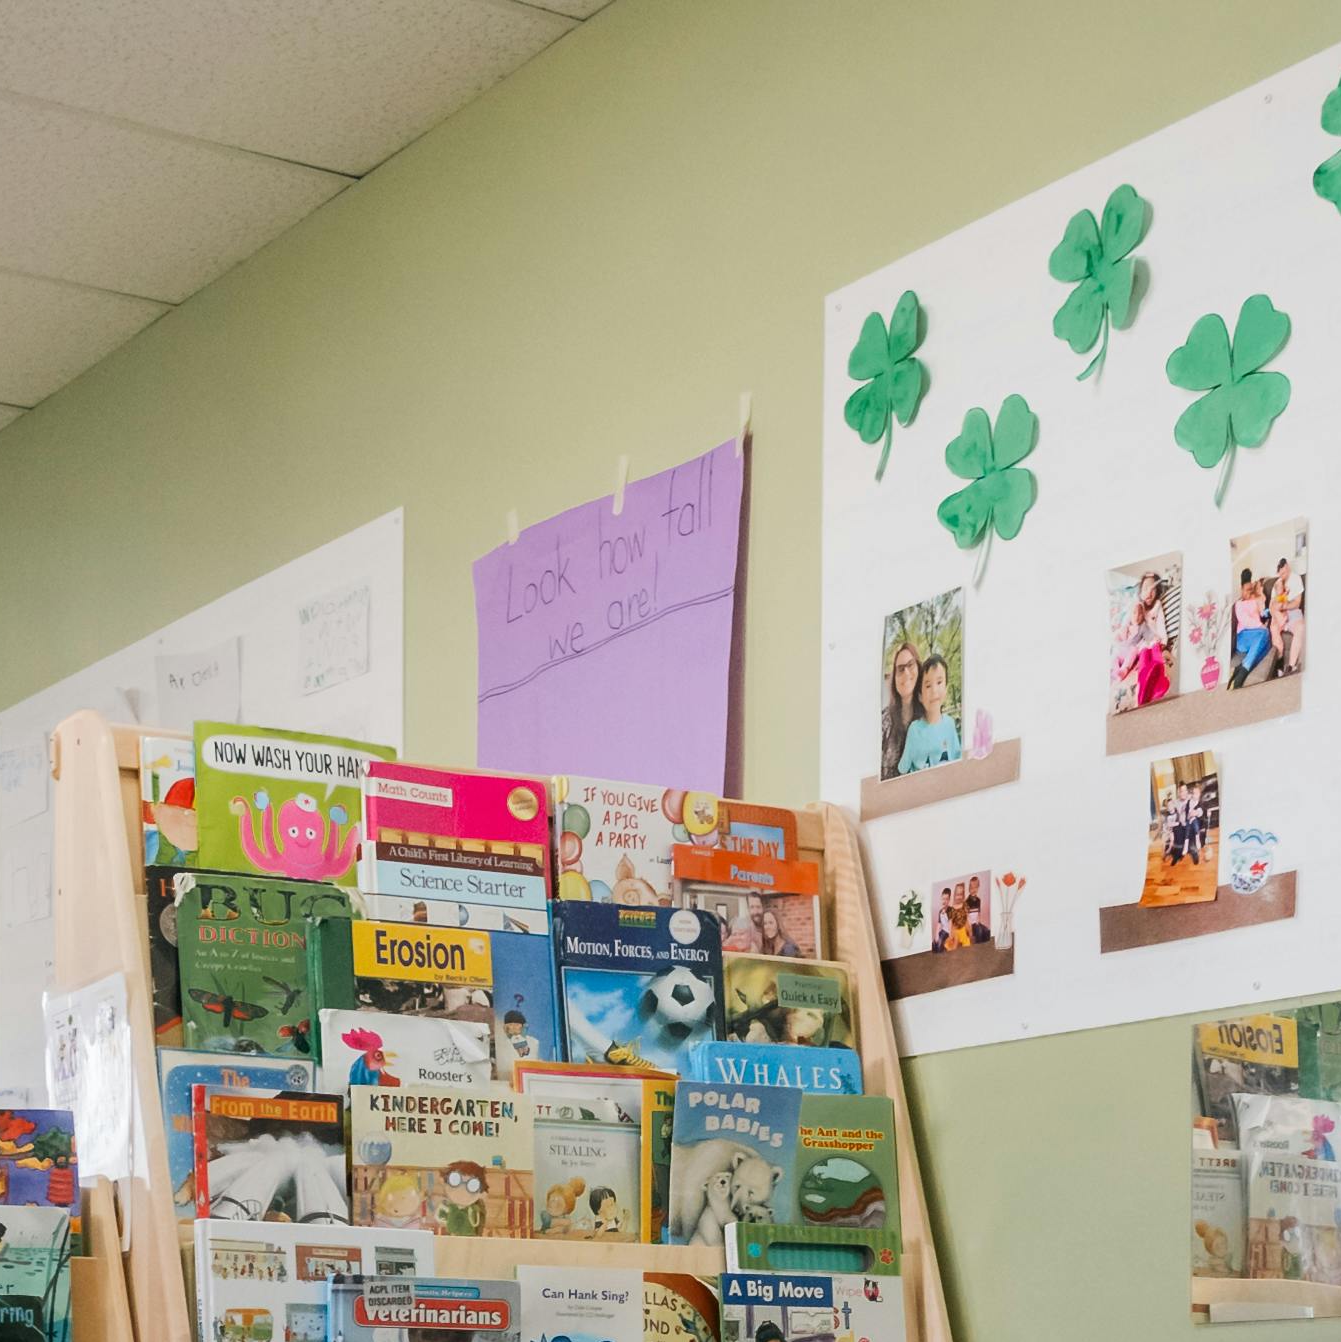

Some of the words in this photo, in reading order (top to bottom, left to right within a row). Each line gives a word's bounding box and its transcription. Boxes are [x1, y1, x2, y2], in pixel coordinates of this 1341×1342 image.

[507, 536, 576, 623] Look
[598, 506, 645, 579] how
[662, 452, 714, 544] tall
[548, 622, 584, 660] we
[607, 552, 658, 630] are!
[214, 742, 246, 765] NOW
[252, 746, 291, 770] WASH
[296, 751, 332, 775] YOUR
[378, 782, 407, 797] Math
[410, 787, 448, 803] Counts
[583, 787, 596, 802] IF
[599, 790, 625, 809] YOU
[627, 793, 657, 812] GIVE
[603, 811, 613, 825] A
[615, 812, 638, 829] PIG
[596, 832, 604, 847] A
[608, 833, 647, 850] PARTY
[389, 846, 396, 857] A
[396, 846, 427, 860] Child's
[429, 850, 448, 861] First
[451, 852, 483, 867] Library
[484, 855, 492, 866] of
[494, 856, 534, 872] Learning
[400, 868, 463, 891] Science
[467, 875, 526, 898] Starter
[375, 930, 465, 970] Erosion
[566, 935, 614, 957] MOTION,
[614, 939, 654, 960] FORCES,
[670, 943, 709, 963] ENERGY
[781, 990, 807, 1001] Quick
[818, 993, 838, 1008] Easy
[221, 1068, 251, 1089] The
[418, 1068, 472, 1083] Rooster's
[715, 1056, 843, 1091] WHALES
[210, 1097, 254, 1116] From
[260, 1101, 282, 1115] the
[289, 1102, 337, 1122] Earth
[369, 1093, 519, 1123] KINDERGARTEN,
[689, 1091, 761, 1114] POLAR
[384, 1116, 427, 1134] HERE
[433, 1117, 442, 1135] I
[448, 1119, 500, 1138] COME!
[705, 1115, 783, 1148] BABIES
[818, 1127, 837, 1137] Ant
[842, 1130, 862, 1138] and
[865, 1130, 883, 1139] the
[803, 1137, 874, 1151] Grasshopper
[391, 1284, 410, 1293] ITEM
[542, 1288, 564, 1299] Can
[568, 1288, 598, 1300] Hank
[601, 1290, 629, 1304] Sing?
[728, 1281, 741, 1296] A
[747, 1281, 775, 1300] Big
[778, 1282, 824, 1299] Move
[368, 1295, 413, 1307] DISCARDED
